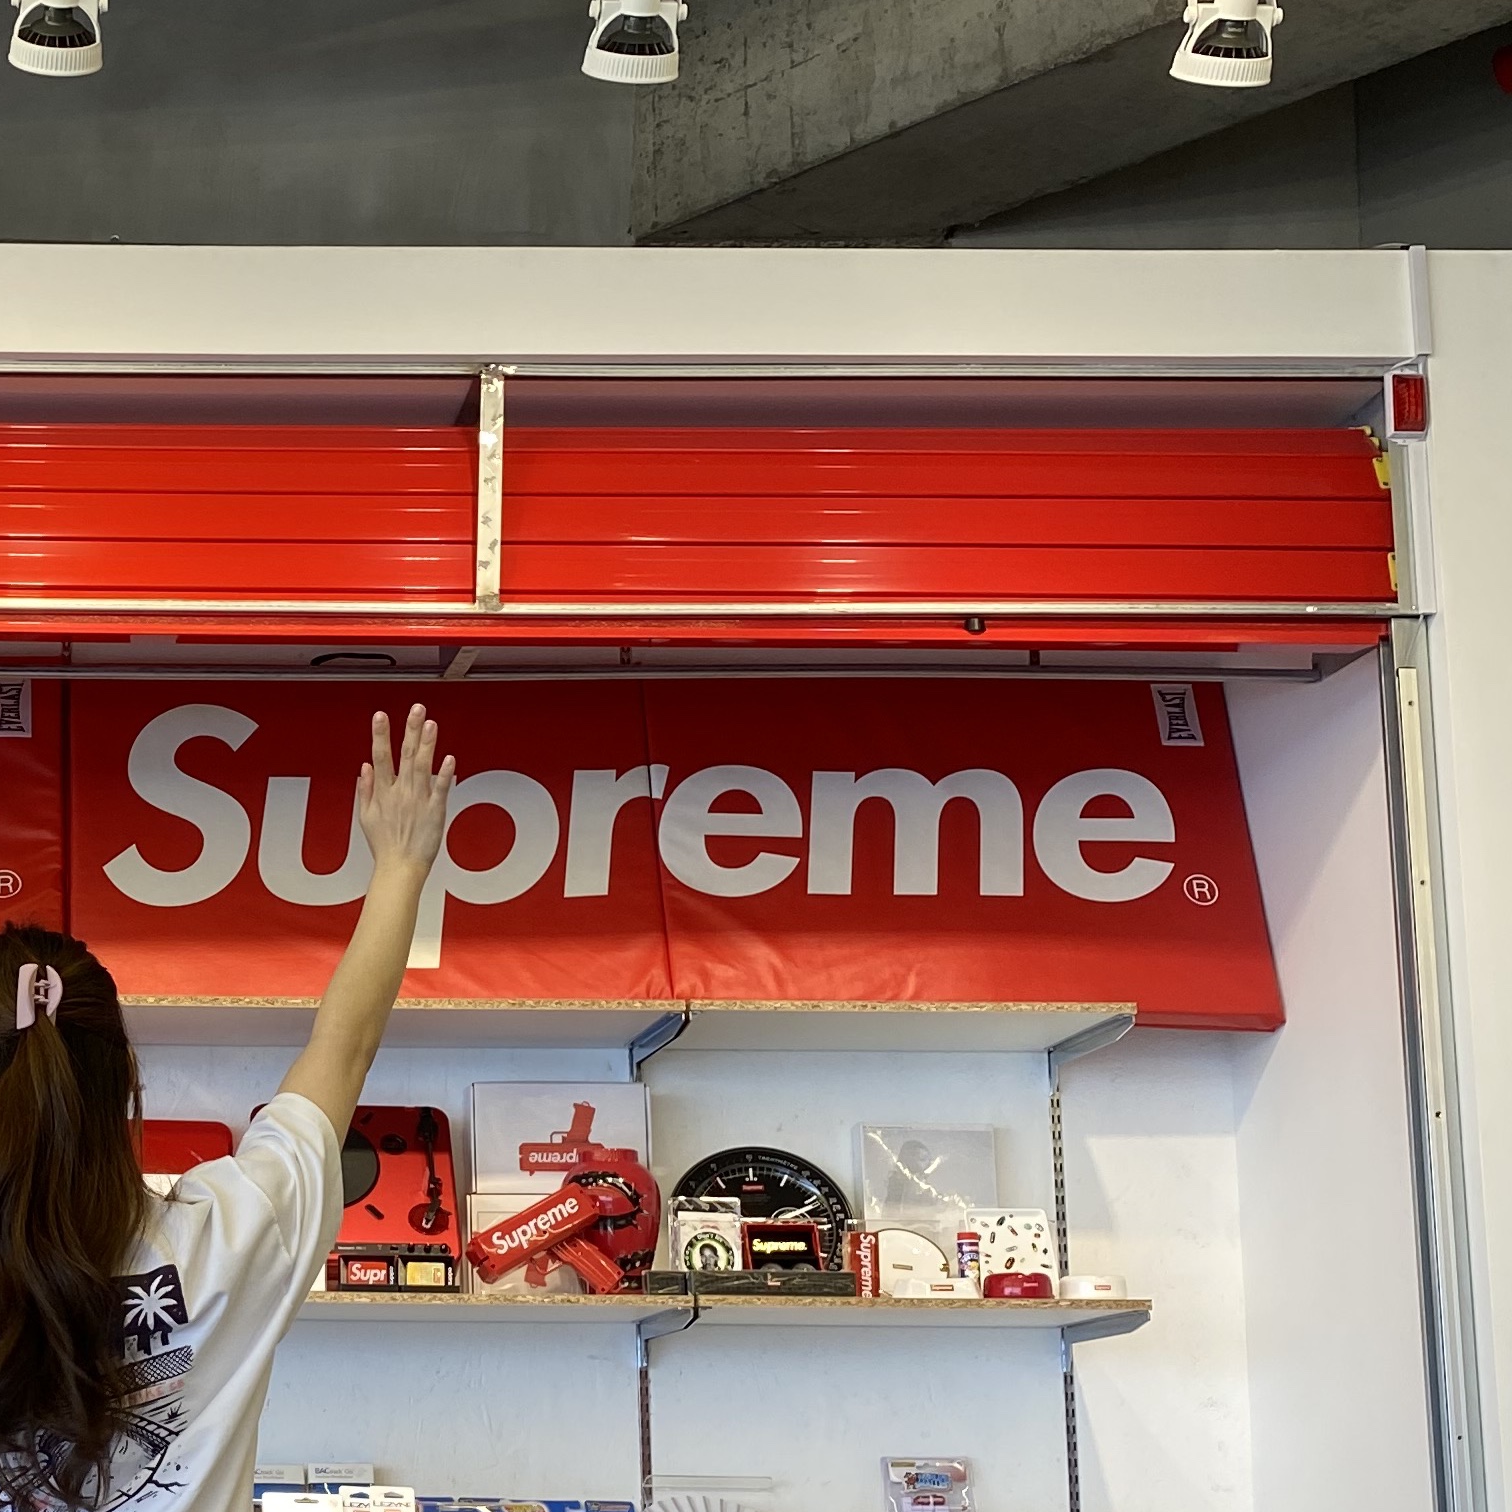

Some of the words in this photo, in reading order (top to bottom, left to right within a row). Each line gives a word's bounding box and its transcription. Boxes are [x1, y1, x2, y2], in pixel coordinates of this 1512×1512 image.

[102, 703, 1176, 969] Supreme
[491, 1197, 580, 1255] Supreme
[855, 1232, 877, 1299] Supreme
